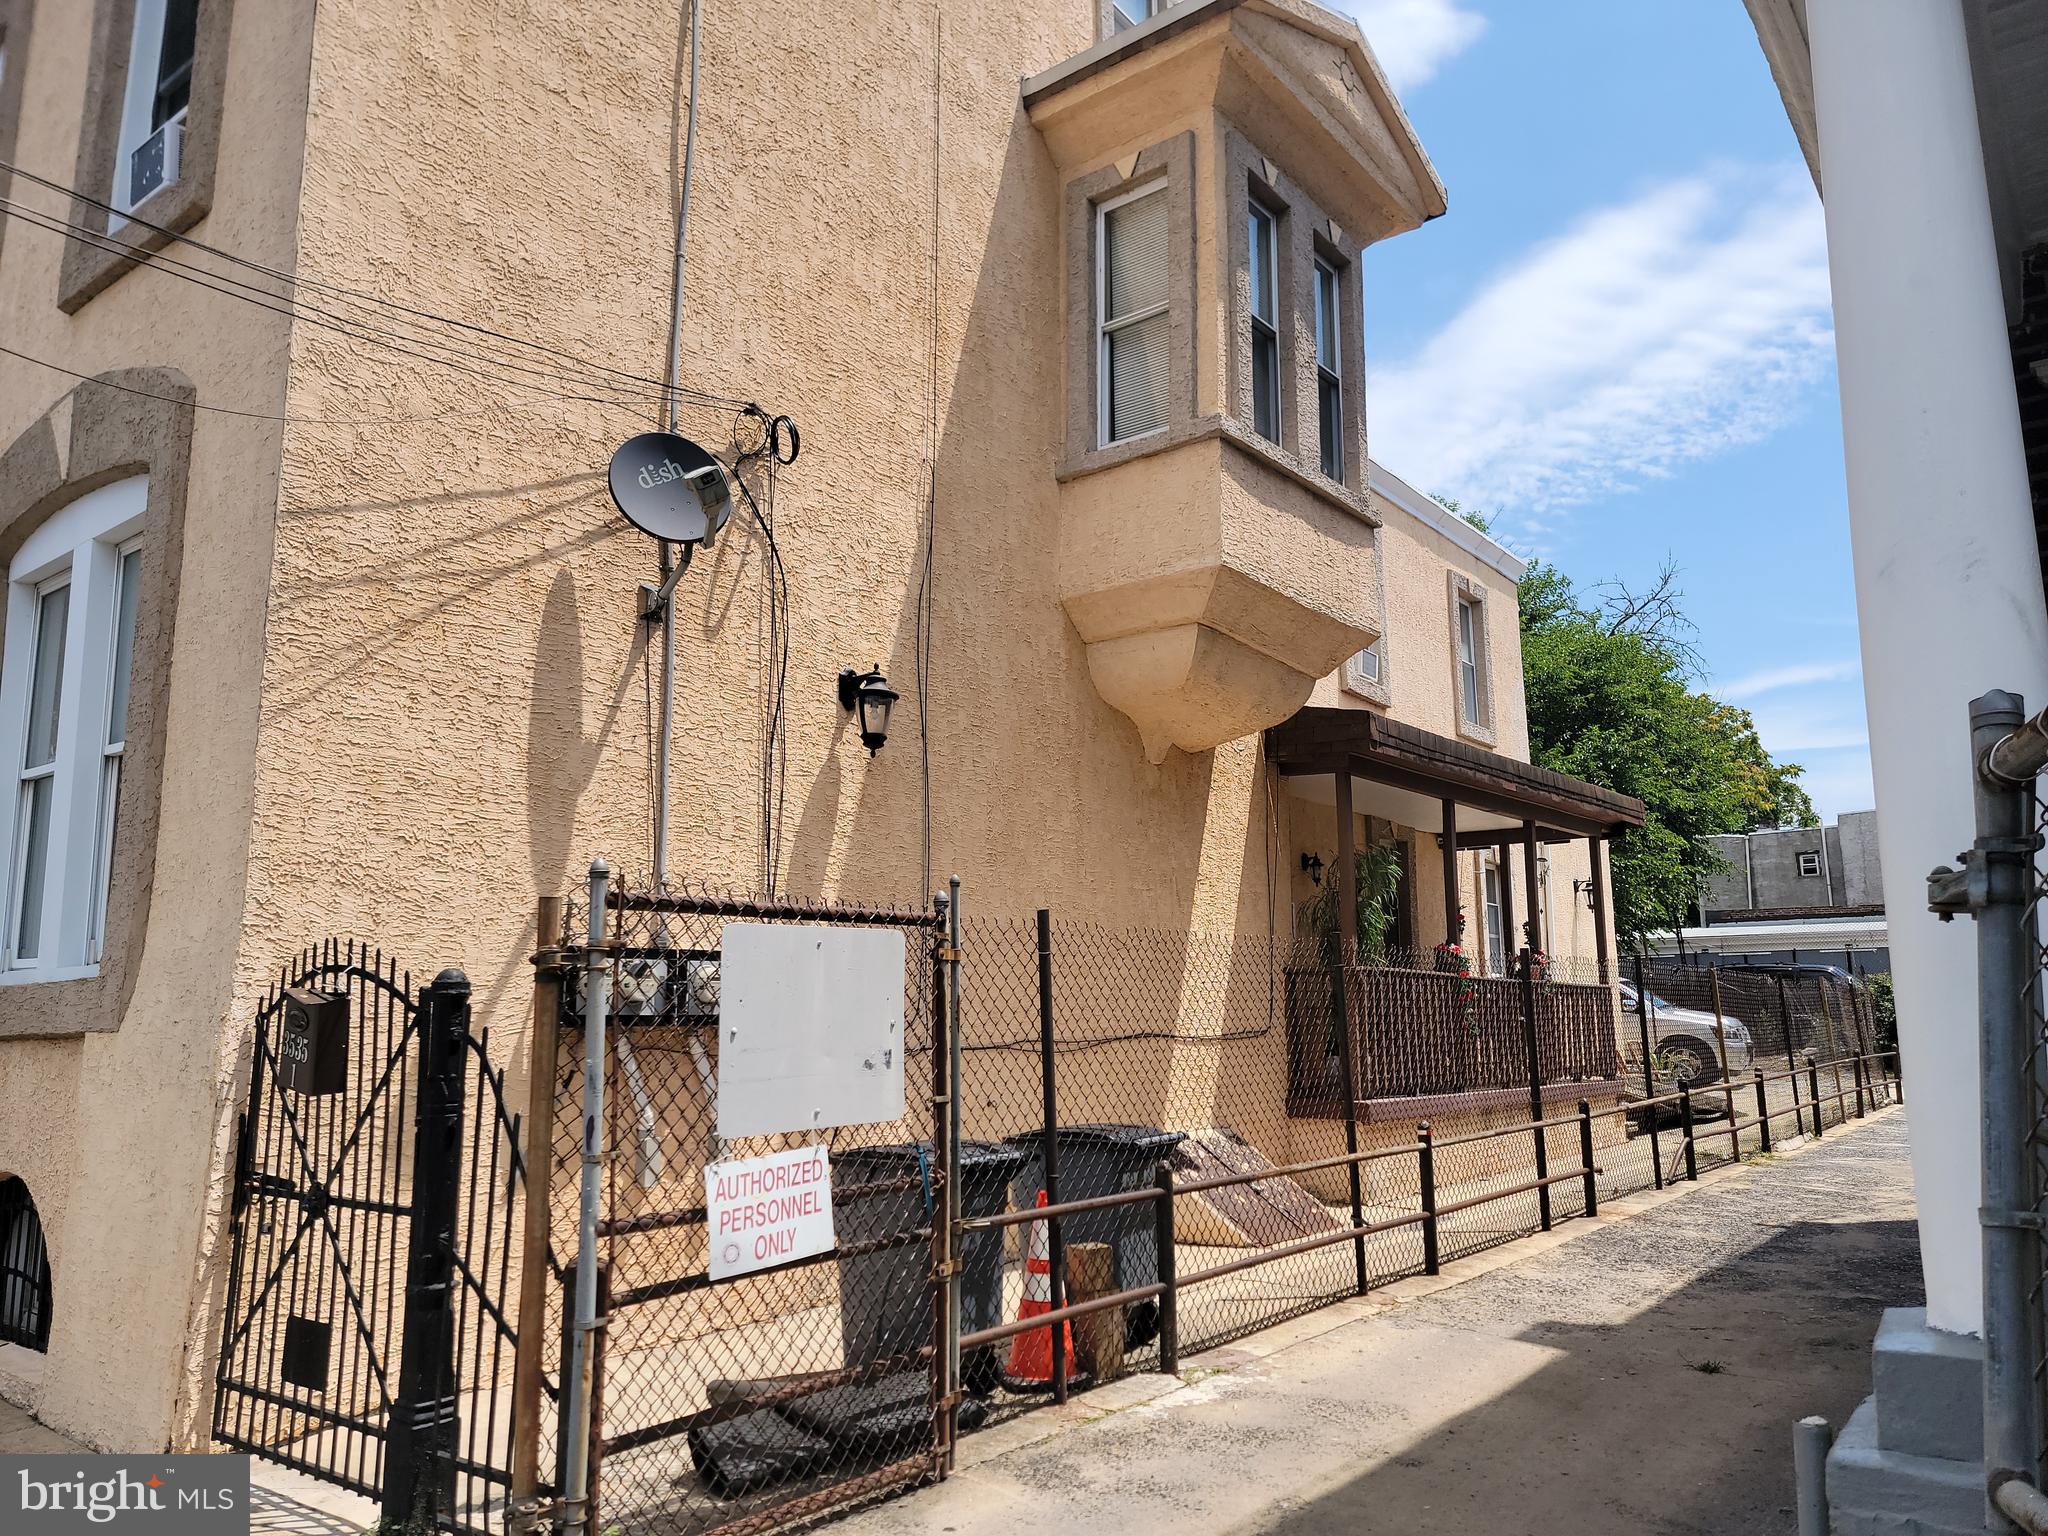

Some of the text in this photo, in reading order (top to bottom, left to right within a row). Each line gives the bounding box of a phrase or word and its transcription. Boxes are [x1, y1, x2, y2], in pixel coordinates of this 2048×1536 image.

[638, 458, 684, 488] dish
[283, 1030, 308, 1063] 3535
[715, 1159, 823, 1203] AUTHORIZED
[720, 1191, 822, 1235] PERSONNEL
[754, 1227, 797, 1260] ONLY
